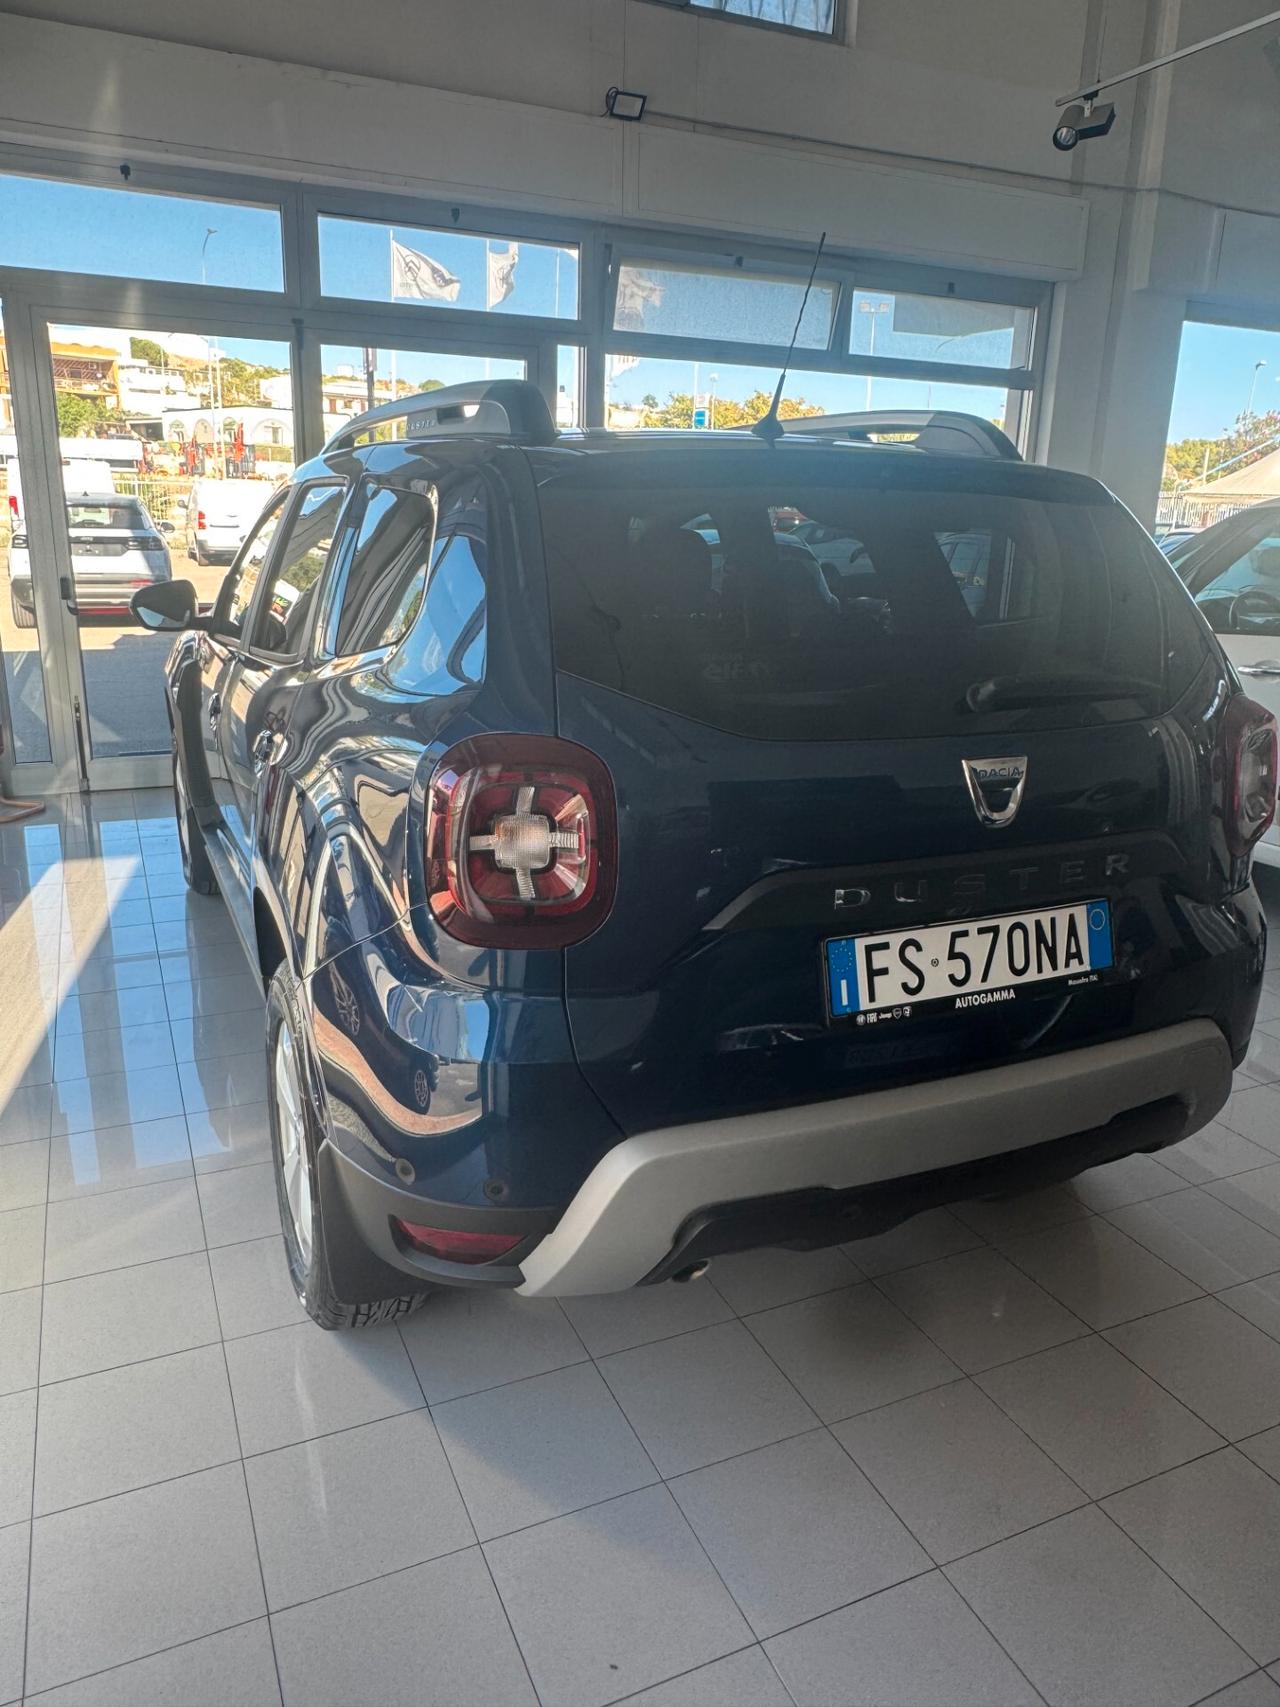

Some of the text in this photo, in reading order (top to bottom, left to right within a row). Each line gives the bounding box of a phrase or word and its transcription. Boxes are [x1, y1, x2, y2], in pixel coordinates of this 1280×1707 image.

[978, 767, 1020, 778] DACIA
[834, 852, 1130, 910] DUSTER
[864, 938, 925, 1004] FS
[947, 913, 1085, 988] 570NA
[955, 989, 1016, 1009] AUTOGAMMA
